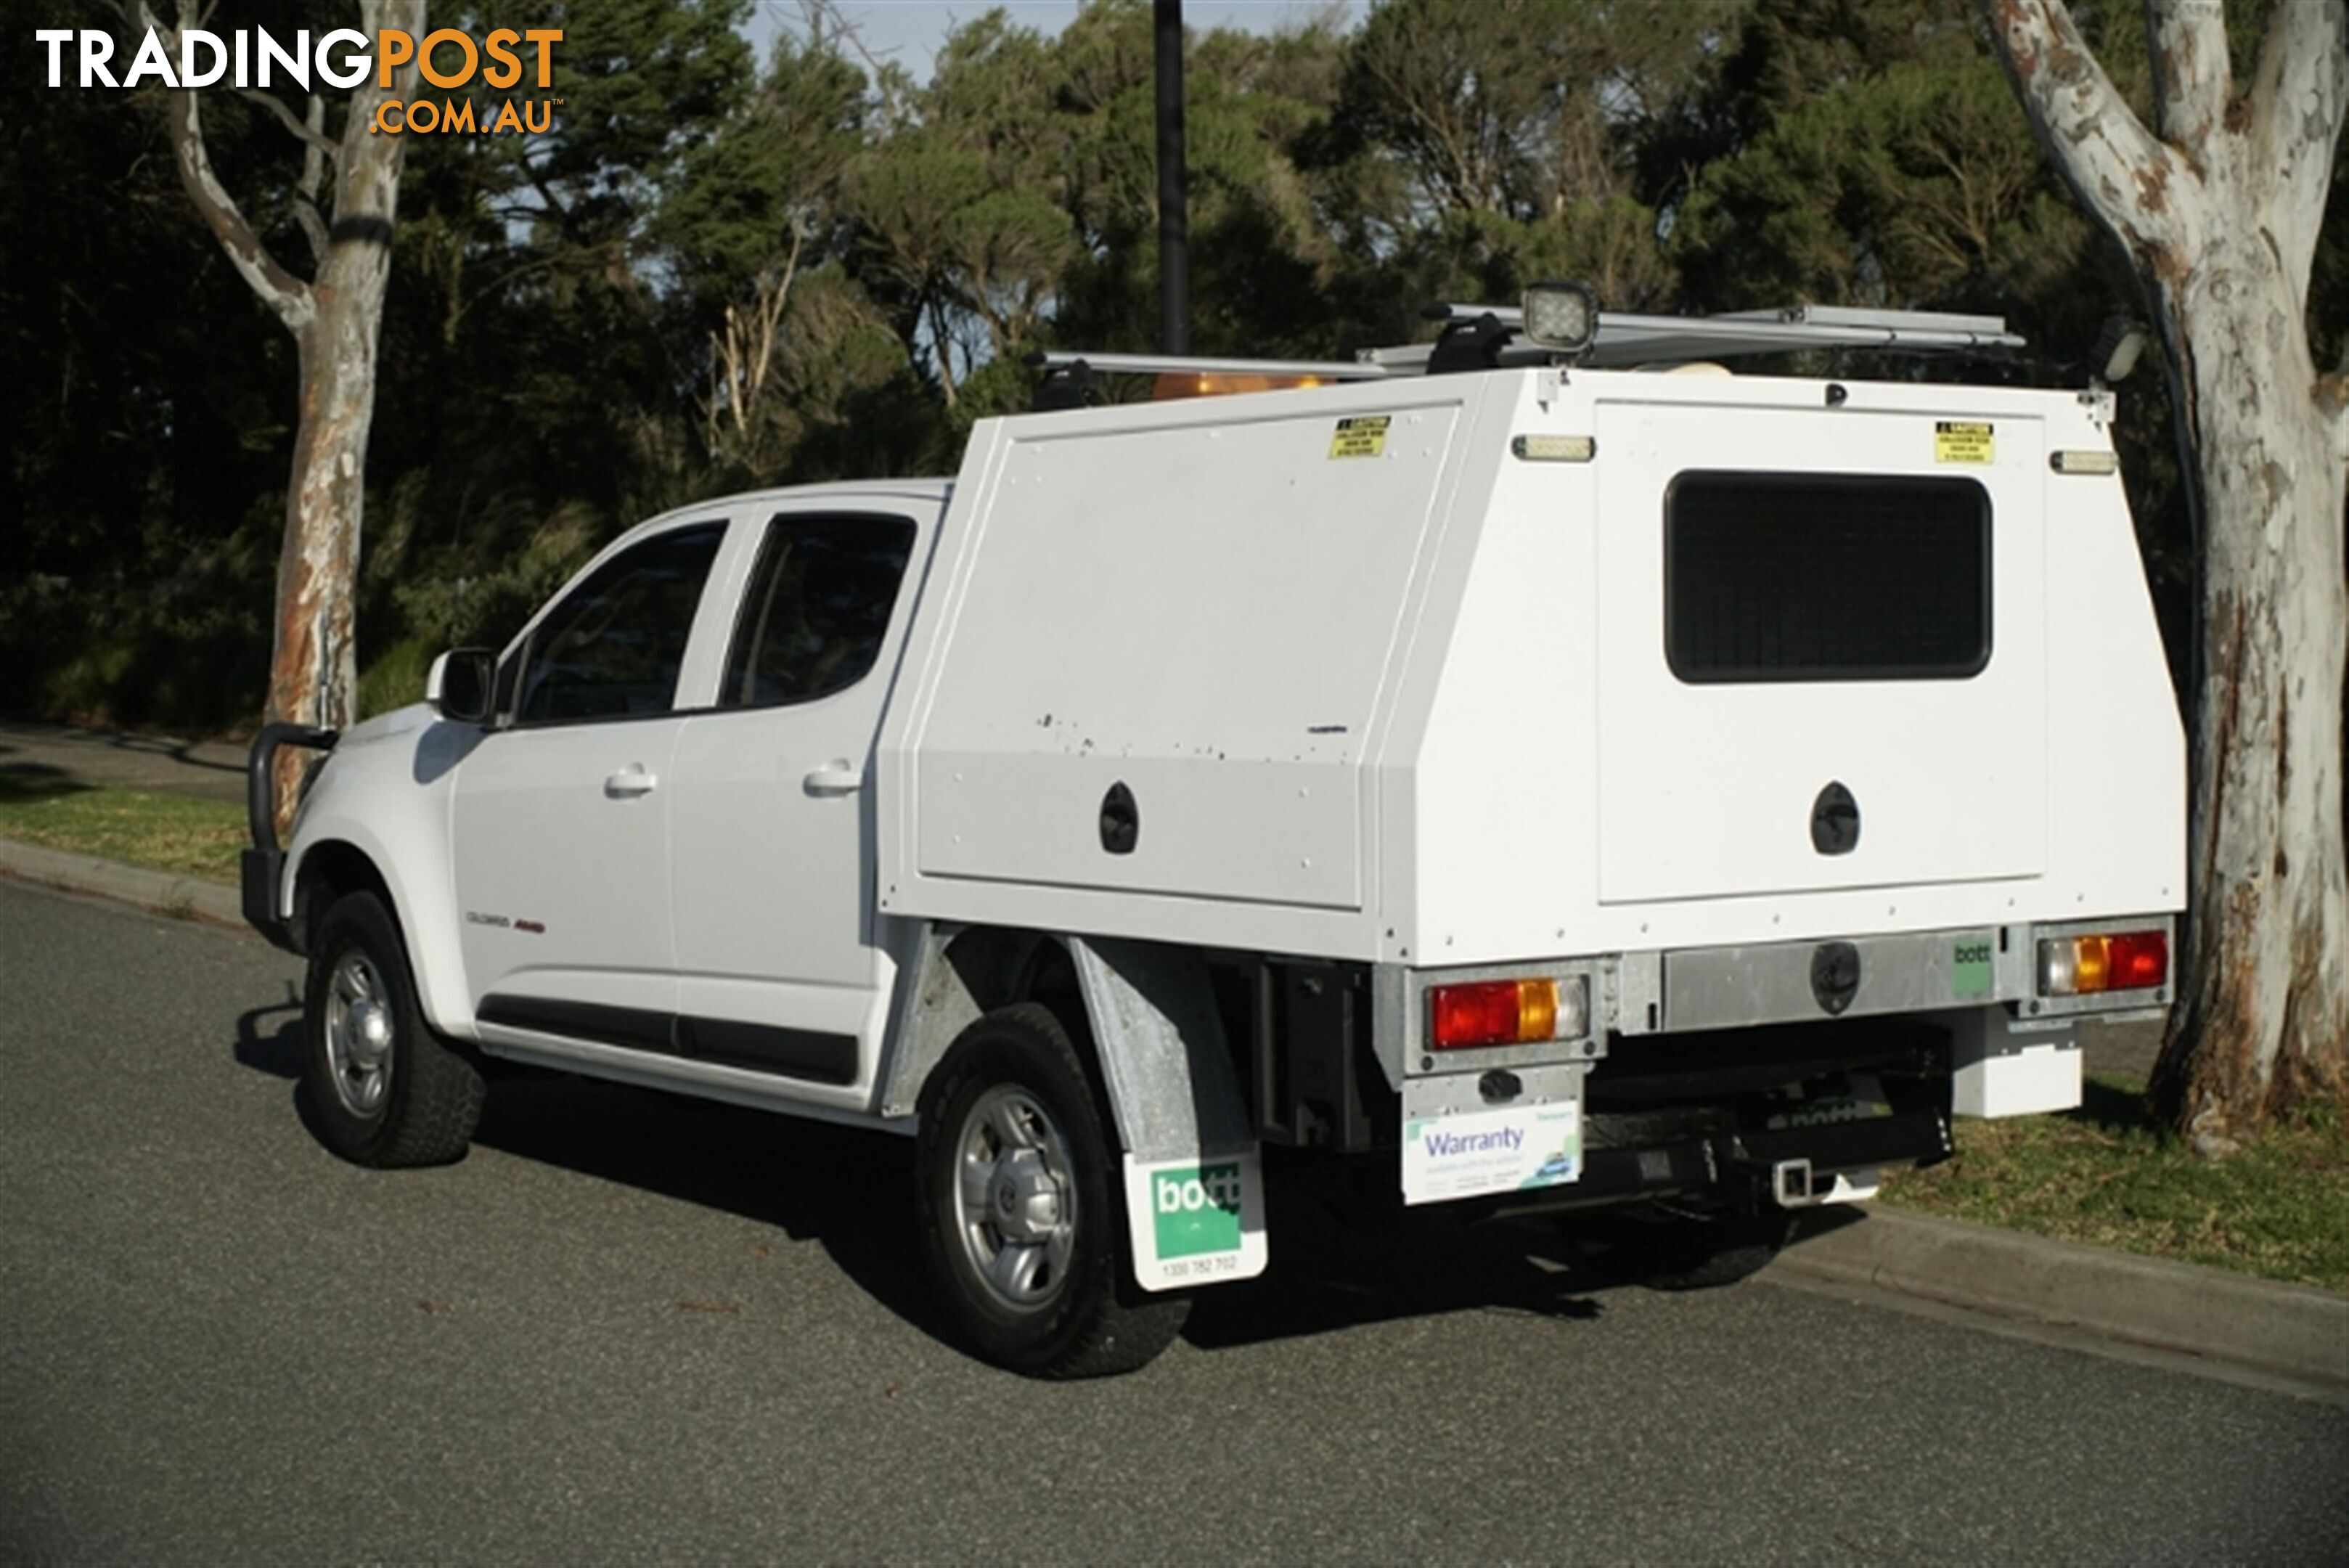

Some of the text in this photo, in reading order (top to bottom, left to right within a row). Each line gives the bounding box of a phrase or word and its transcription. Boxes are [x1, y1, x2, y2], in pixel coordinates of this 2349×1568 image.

[1954, 944, 1990, 964] bott
[1425, 1126, 1524, 1157] Warranty
[1157, 1170, 1241, 1213] bott
